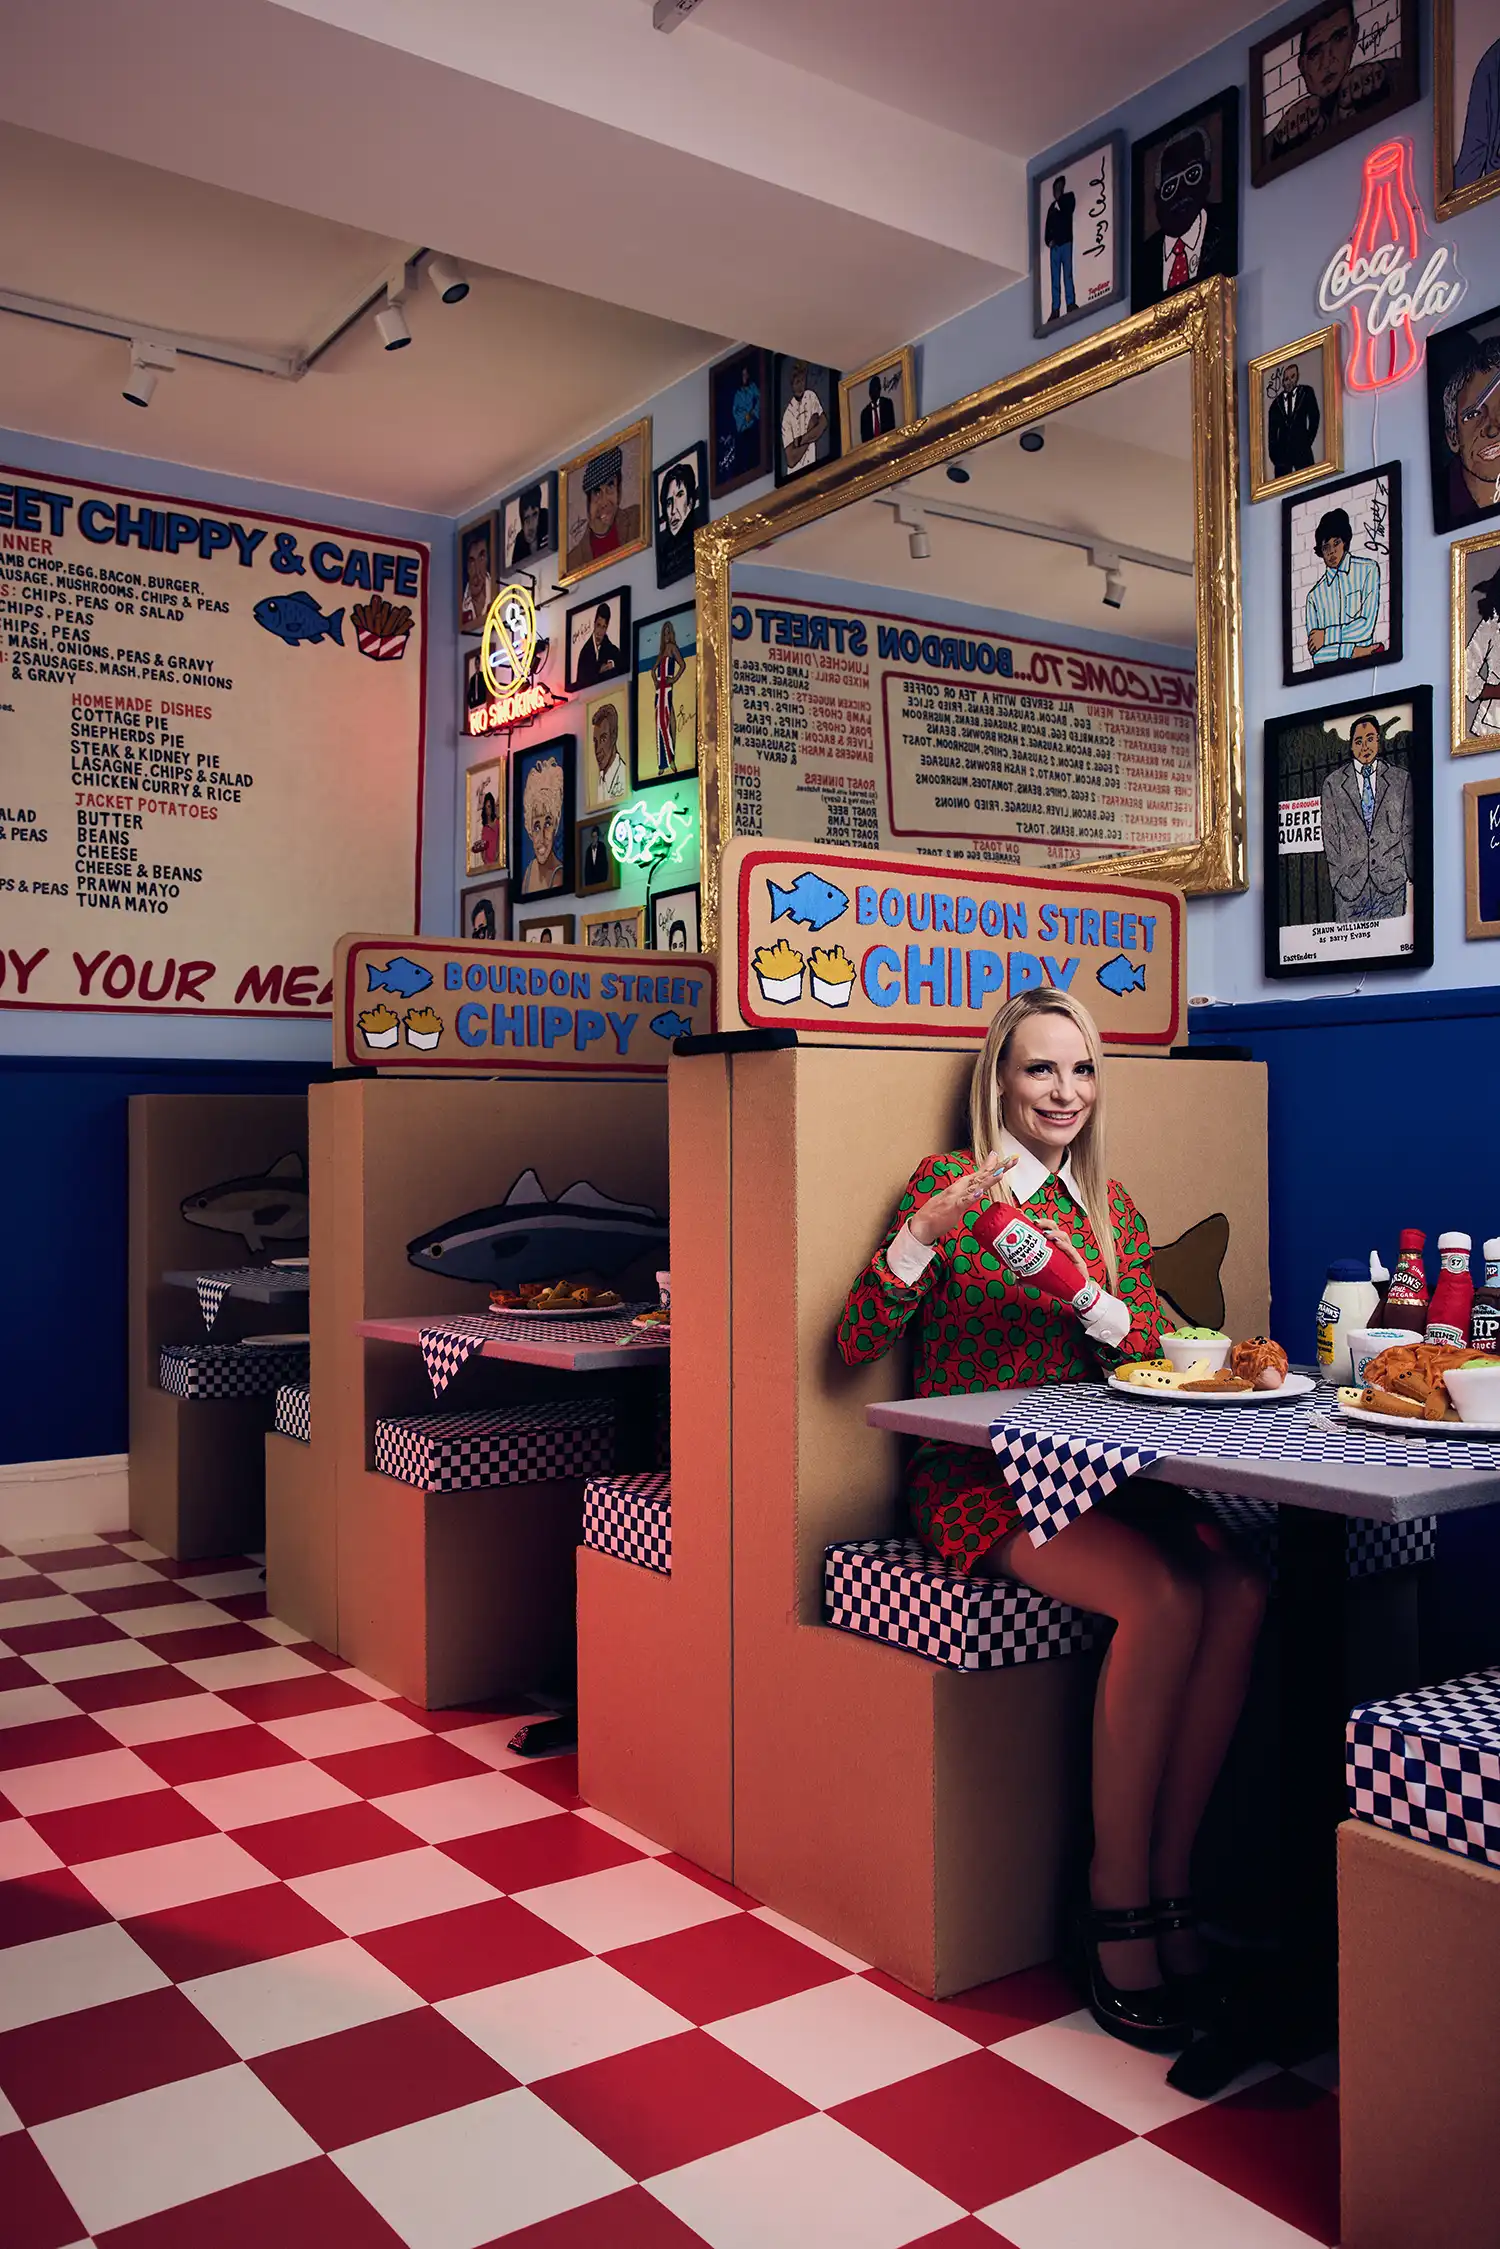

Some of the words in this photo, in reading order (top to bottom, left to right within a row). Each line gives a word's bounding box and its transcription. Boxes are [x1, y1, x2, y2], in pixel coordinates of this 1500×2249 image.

[1319, 243, 1404, 312] Coca
[1367, 247, 1461, 335] Cola
[78, 499, 268, 567] CHIPPY
[270, 532, 306, 576] &
[310, 541, 419, 598] CAFE
[55, 608, 94, 625] PEAS
[76, 595, 108, 610] PEAS
[114, 602, 134, 615] OR
[140, 605, 184, 622] SALAD
[182, 598, 193, 608] &
[197, 599, 230, 613] PEAS
[51, 625, 91, 642] PEAS
[117, 649, 150, 664] PEAS
[154, 654, 164, 667] &
[167, 656, 214, 673] GRAVY
[11, 666, 22, 680] &
[27, 669, 76, 685] GRAVY
[183, 674, 233, 690] ONIONS
[72, 693, 153, 713] HOMEMADE
[160, 701, 212, 720] DISHES
[470, 709, 488, 735] NO
[488, 685, 546, 726] SMOKING
[71, 707, 141, 727] COTTAGE
[145, 715, 169, 731] PIE
[70, 723, 155, 745] SHEPHERDS
[160, 733, 184, 748] PIE
[70, 740, 120, 758] STEAK
[124, 745, 135, 759] &
[138, 748, 190, 766] KIDNEY
[197, 753, 220, 768] PIE
[71, 772, 139, 791] CHICKEN
[142, 778, 189, 797] CURRY
[192, 784, 202, 798] &
[207, 786, 241, 802] RICE
[150, 763, 193, 782] CHIPS
[196, 770, 207, 783] &
[210, 771, 253, 788] SALAD
[75, 792, 133, 811] JACKET
[137, 797, 218, 820] POTATOES
[77, 809, 143, 830] BUTTER
[11, 827, 48, 842] PEAS
[77, 827, 130, 845] BEANS
[76, 844, 138, 862] CHEESE
[75, 860, 132, 877] CHEESE
[136, 864, 148, 878] &
[152, 864, 203, 882] BEANS
[18, 880, 29, 893] &
[32, 881, 69, 896] PEAS
[77, 876, 131, 894] PRAWN
[136, 881, 180, 898] MAYO
[76, 893, 121, 909] TUNA
[125, 896, 168, 915] MAYO
[855, 885, 1028, 940] BOURDON
[1038, 902, 1156, 953] STREET
[1312, 926, 1335, 936] SHAUN
[72, 950, 216, 1003] YOUR
[444, 962, 591, 999] BOURDON
[600, 972, 703, 1008] STREET
[860, 944, 1081, 1009] CHIPPY
[456, 1002, 639, 1055] CHIPPY
[1008, 1234, 1033, 1260] KETCHUP
[1012, 1238, 1038, 1264] TOMATO
[1023, 1250, 1045, 1270] HEINZ
[1486, 1266, 1497, 1275] HP
[1429, 1331, 1455, 1341] HEINZ
[1472, 1319, 1499, 1336] HP
[1472, 1341, 1497, 1350] SAUCE
